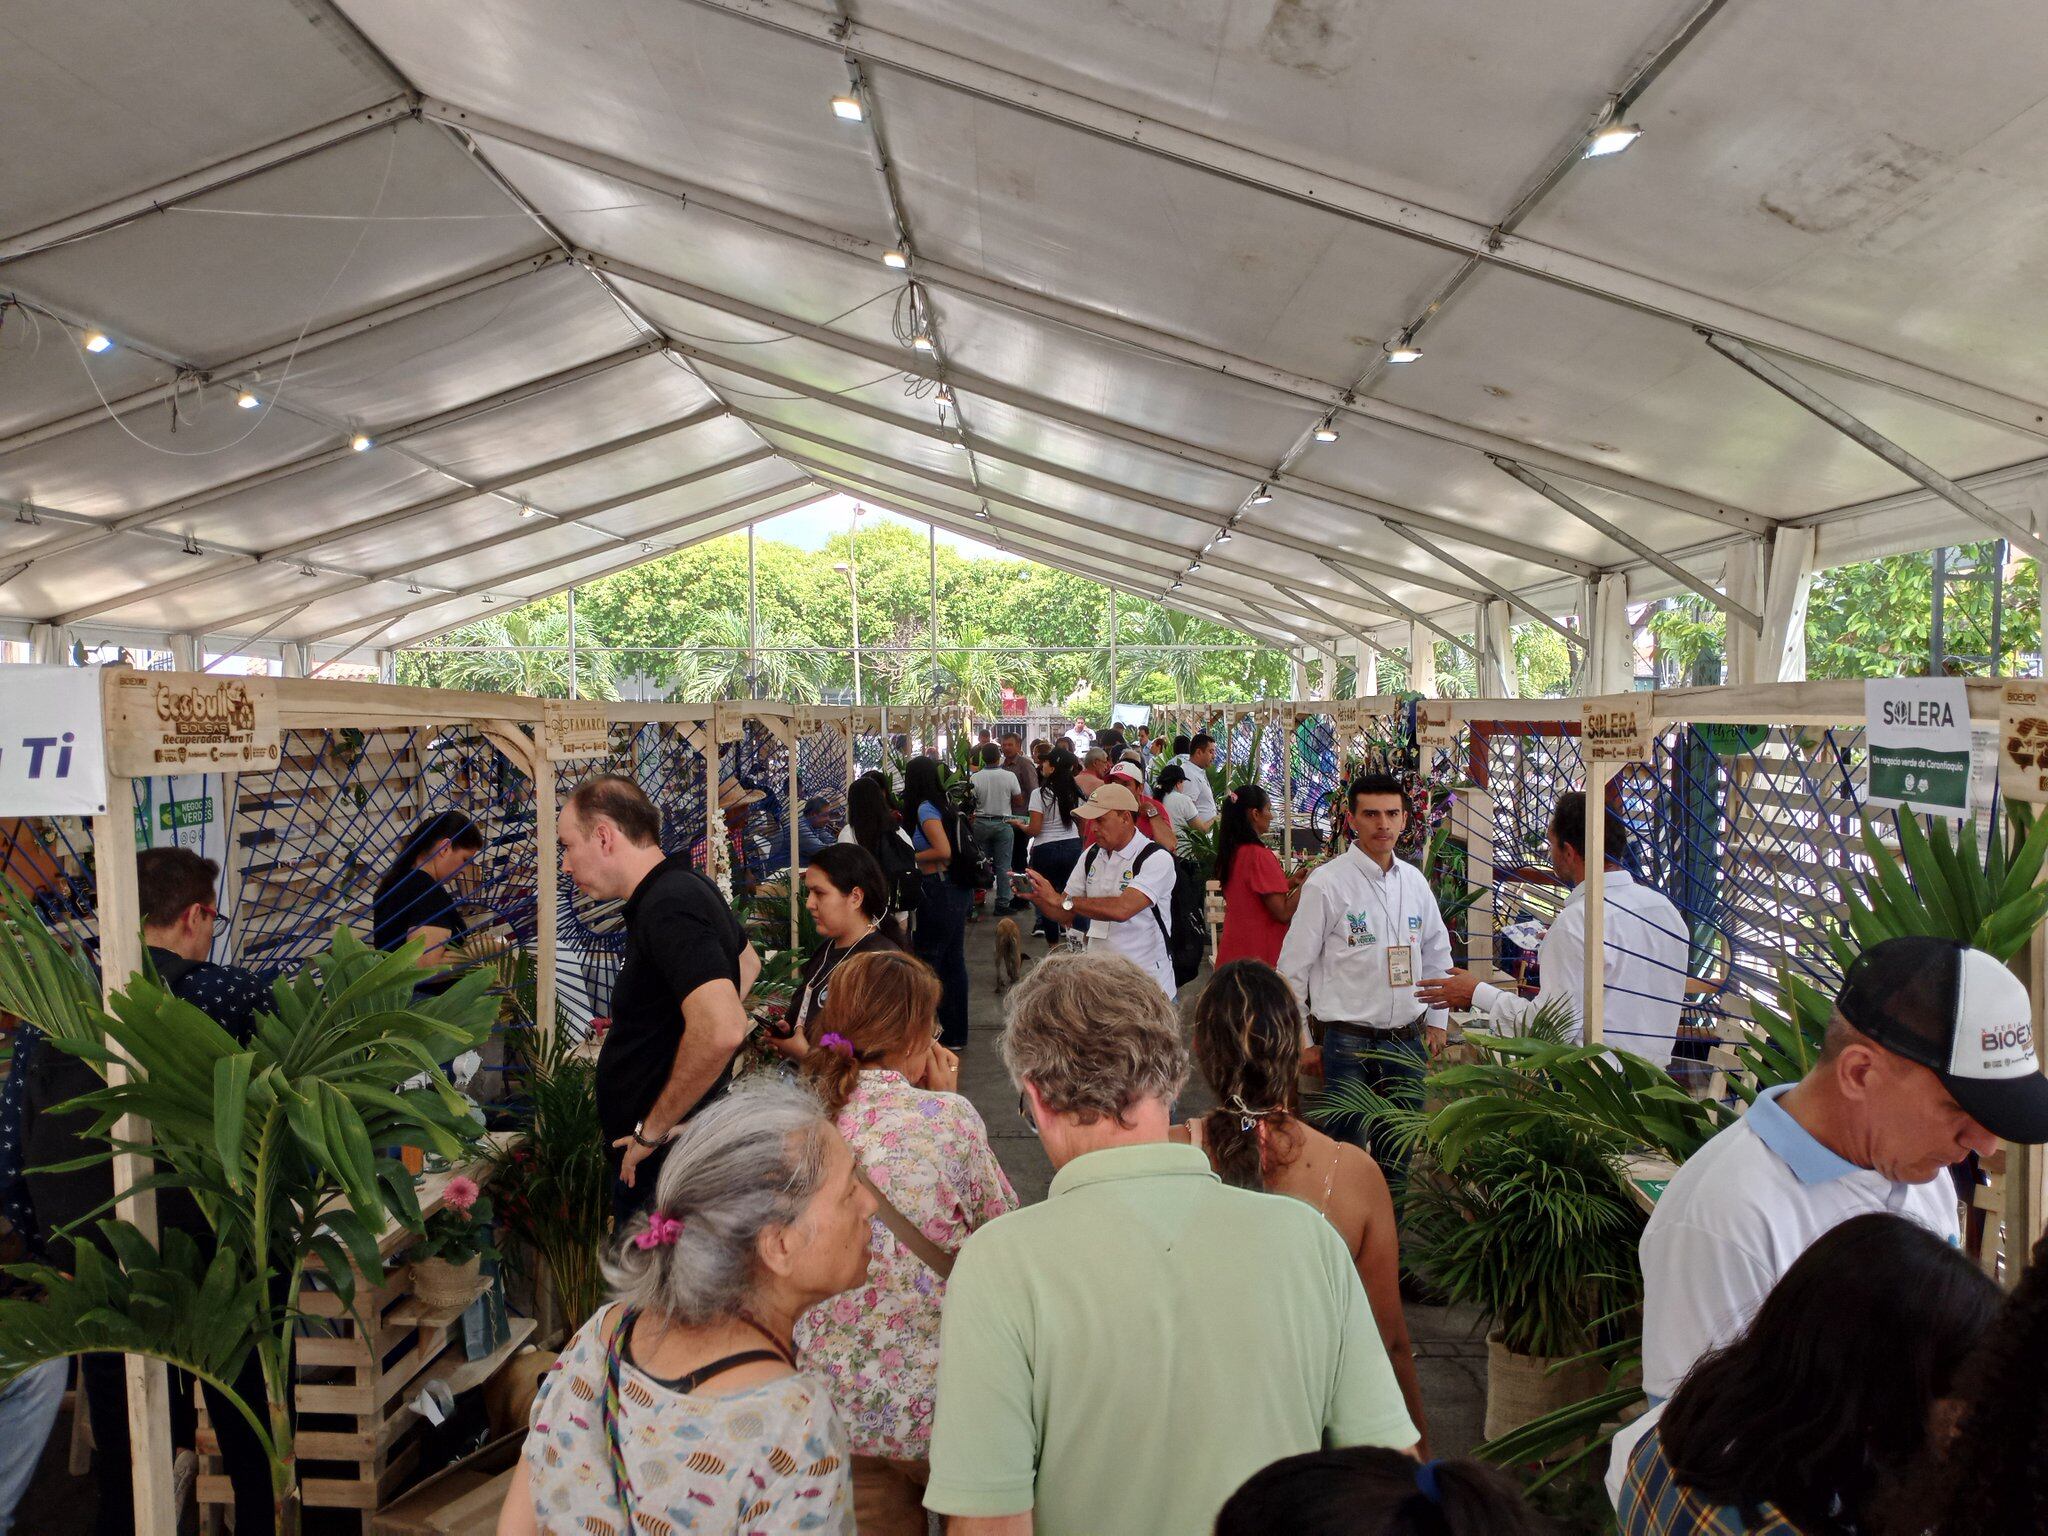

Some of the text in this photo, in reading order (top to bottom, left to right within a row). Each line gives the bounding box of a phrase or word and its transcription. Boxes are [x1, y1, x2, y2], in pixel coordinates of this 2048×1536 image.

[1883, 700, 1955, 728] SOLERA
[180, 723, 229, 734] BOLSAS
[1587, 711, 1638, 739] SOLERA
[162, 733, 254, 746] Recuperadas Para Ti
[22, 732, 75, 779] Ti
[1872, 755, 1880, 764] Un
[1880, 756, 1901, 767] negocio
[1901, 758, 1917, 767] verde
[1917, 759, 1926, 768] de
